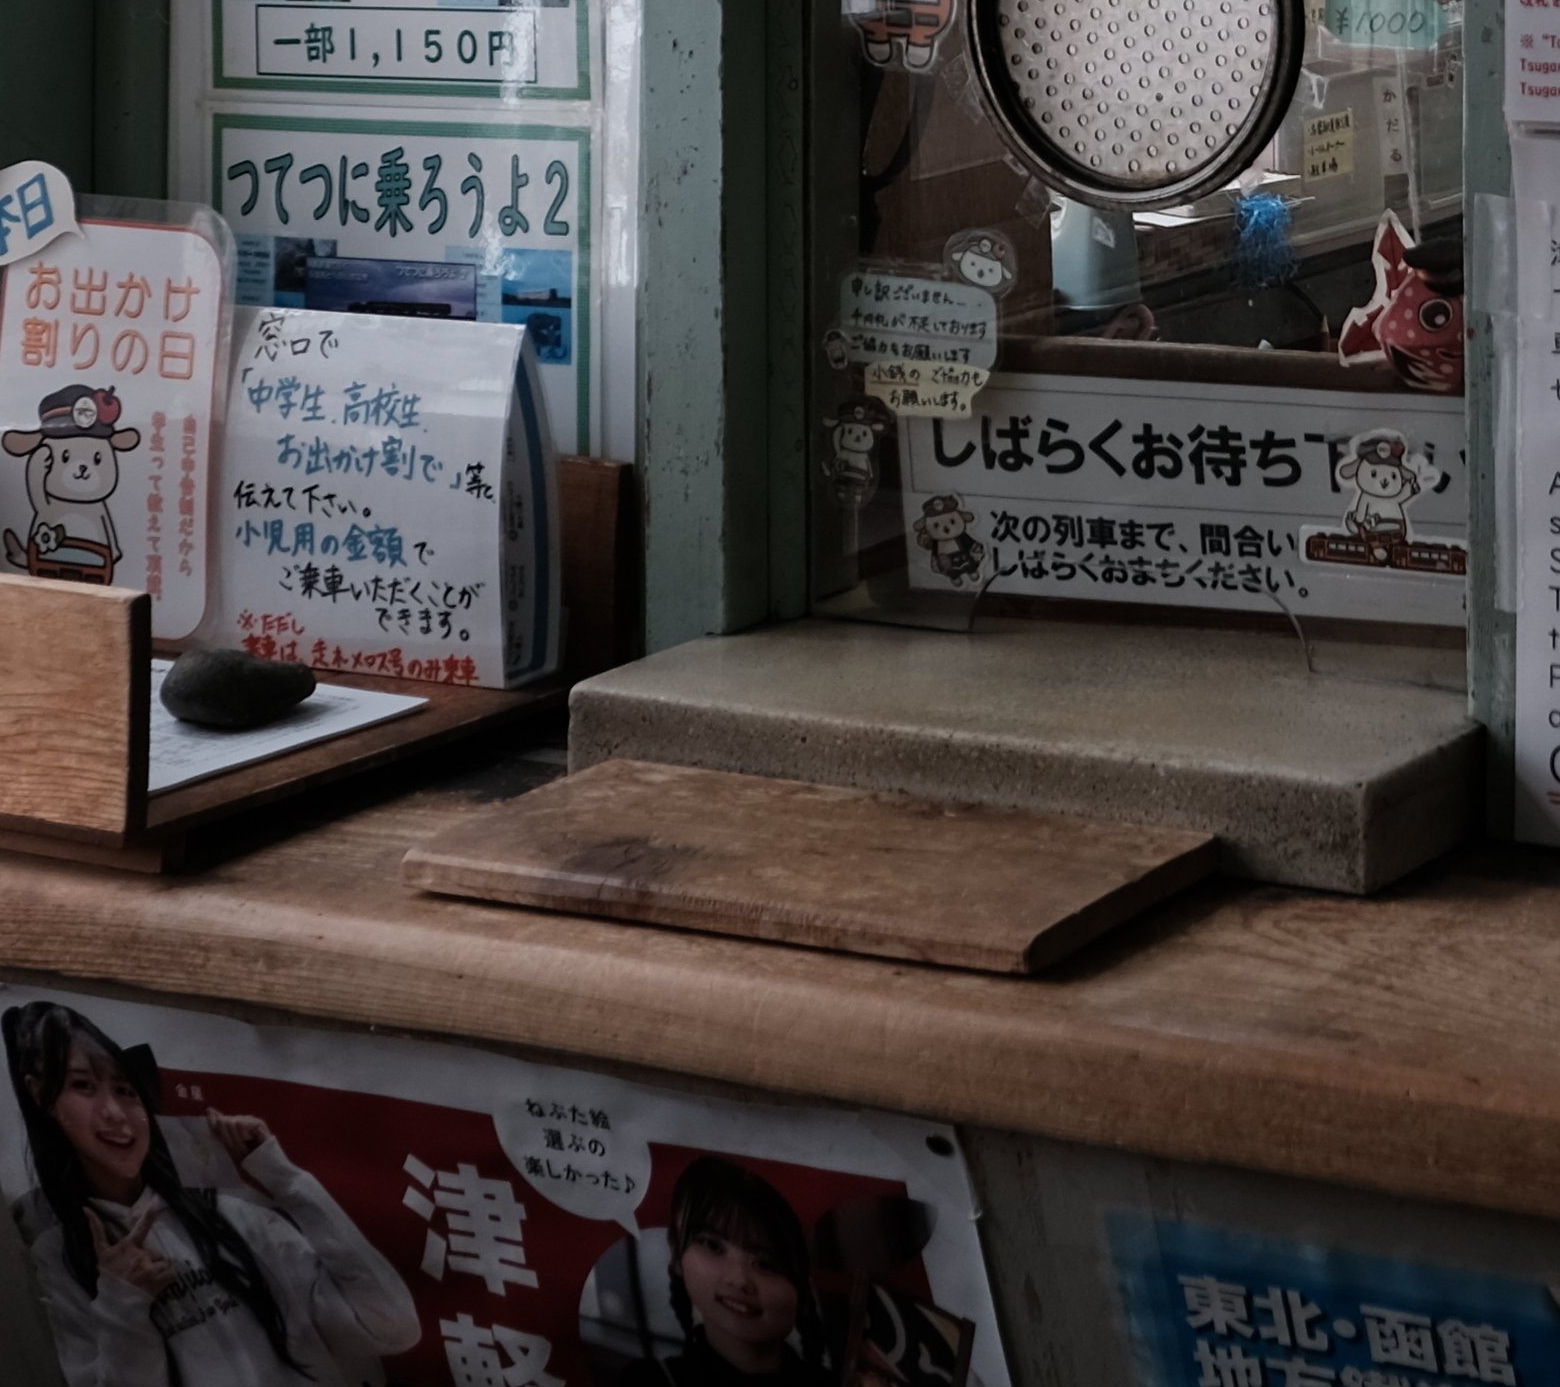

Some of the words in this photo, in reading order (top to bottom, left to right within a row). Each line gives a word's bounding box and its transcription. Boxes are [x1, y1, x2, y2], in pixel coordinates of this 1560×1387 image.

[227, 147, 570, 237] つてつに乗ろうよ2
[25, 264, 200, 323] お出かけ
[21, 315, 197, 380] 割りの日
[253, 313, 339, 361] 窓口で
[376, 605, 470, 641] できます。
[524, 1096, 613, 1132] ねぶた絵
[1177, 1271, 1518, 1387] 東北・函館
